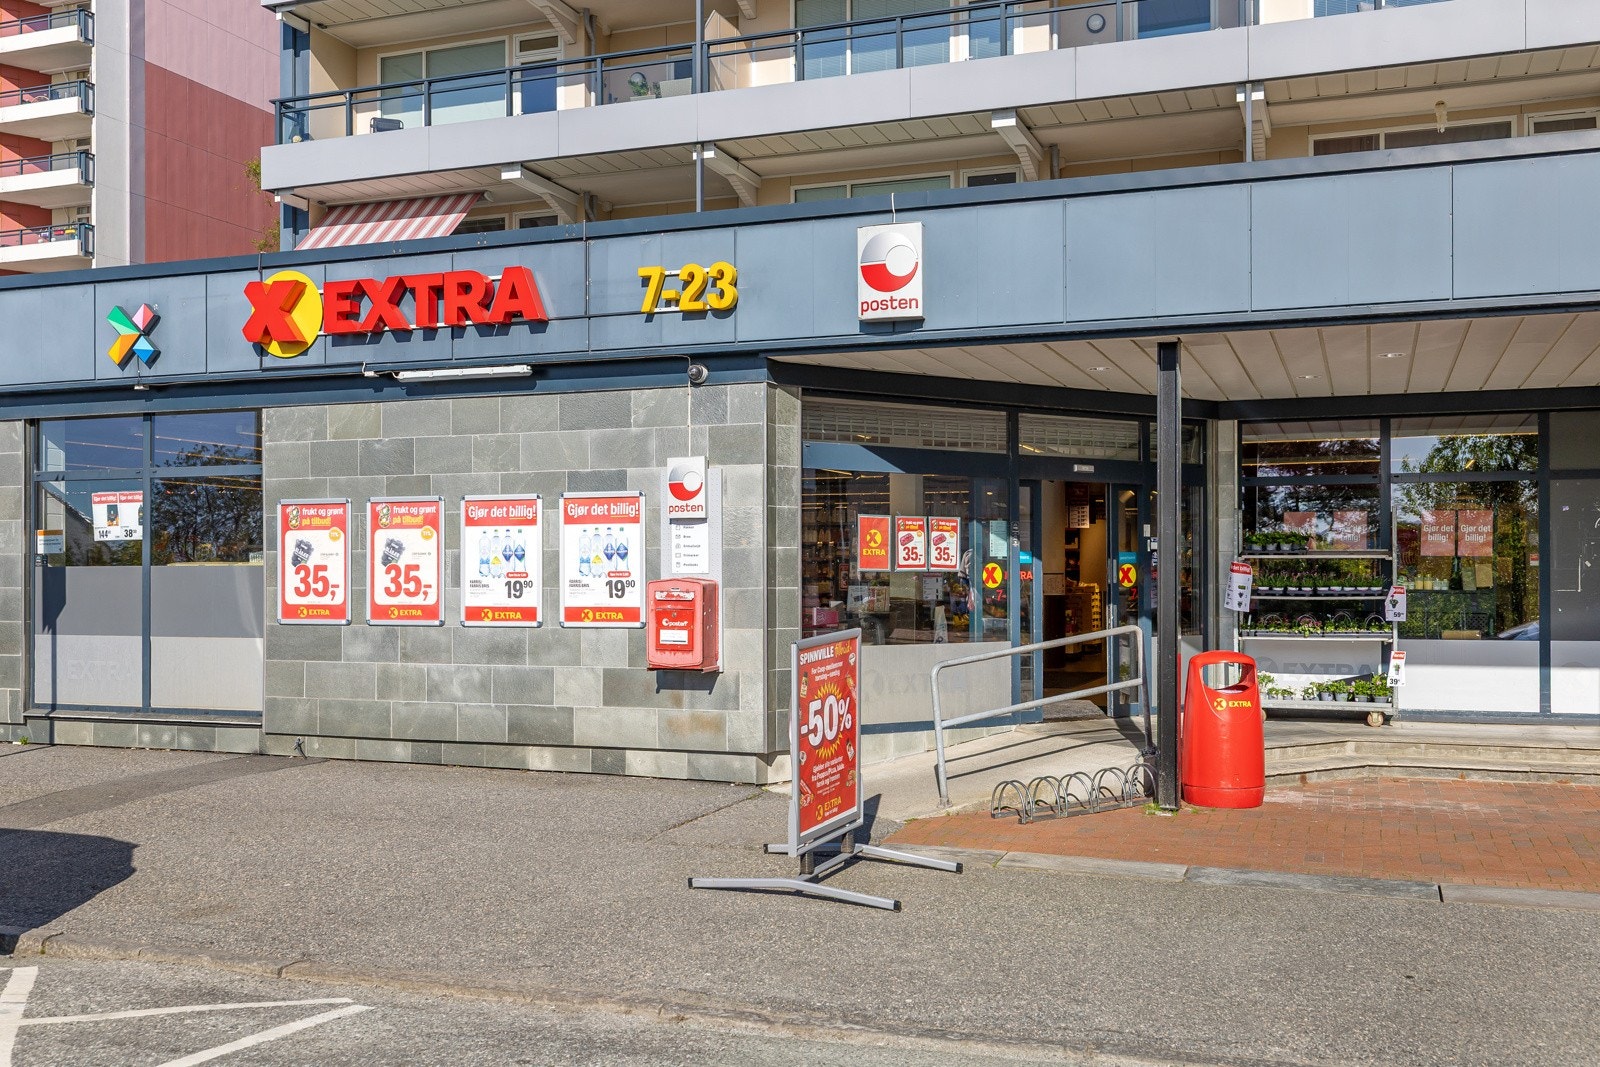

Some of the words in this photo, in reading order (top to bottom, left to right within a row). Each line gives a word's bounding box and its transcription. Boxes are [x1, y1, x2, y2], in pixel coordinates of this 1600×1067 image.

[637, 261, 738, 314] 7-23
[323, 265, 549, 336] EXTRA
[860, 295, 919, 316] posten
[302, 508, 317, 516] frukt
[318, 509, 326, 517] og
[327, 508, 343, 516] grønt
[393, 506, 408, 514] frukt
[418, 506, 436, 514] grønt
[468, 506, 489, 520] Gjør
[491, 506, 507, 517] det
[509, 505, 536, 520] billig!
[567, 504, 589, 518] Gjør
[591, 504, 608, 516] det
[610, 502, 639, 518] billig!
[668, 503, 704, 514] posten
[1424, 524, 1439, 534] Gjør
[1440, 524, 1454, 532] det
[1460, 524, 1476, 534] Gjør
[1478, 524, 1491, 532] det
[1427, 534, 1449, 543] billig!
[1465, 534, 1486, 543] billig!
[862, 548, 886, 556] EXTRA
[308, 608, 330, 616] EXTRA
[495, 611, 522, 619] EXTRA
[596, 611, 623, 620] EXTRA
[800, 646, 834, 666] SPINNVILLE
[1228, 700, 1252, 708] EXTRA
[800, 695, 852, 747] -50%
[824, 797, 842, 810] EXTRA
